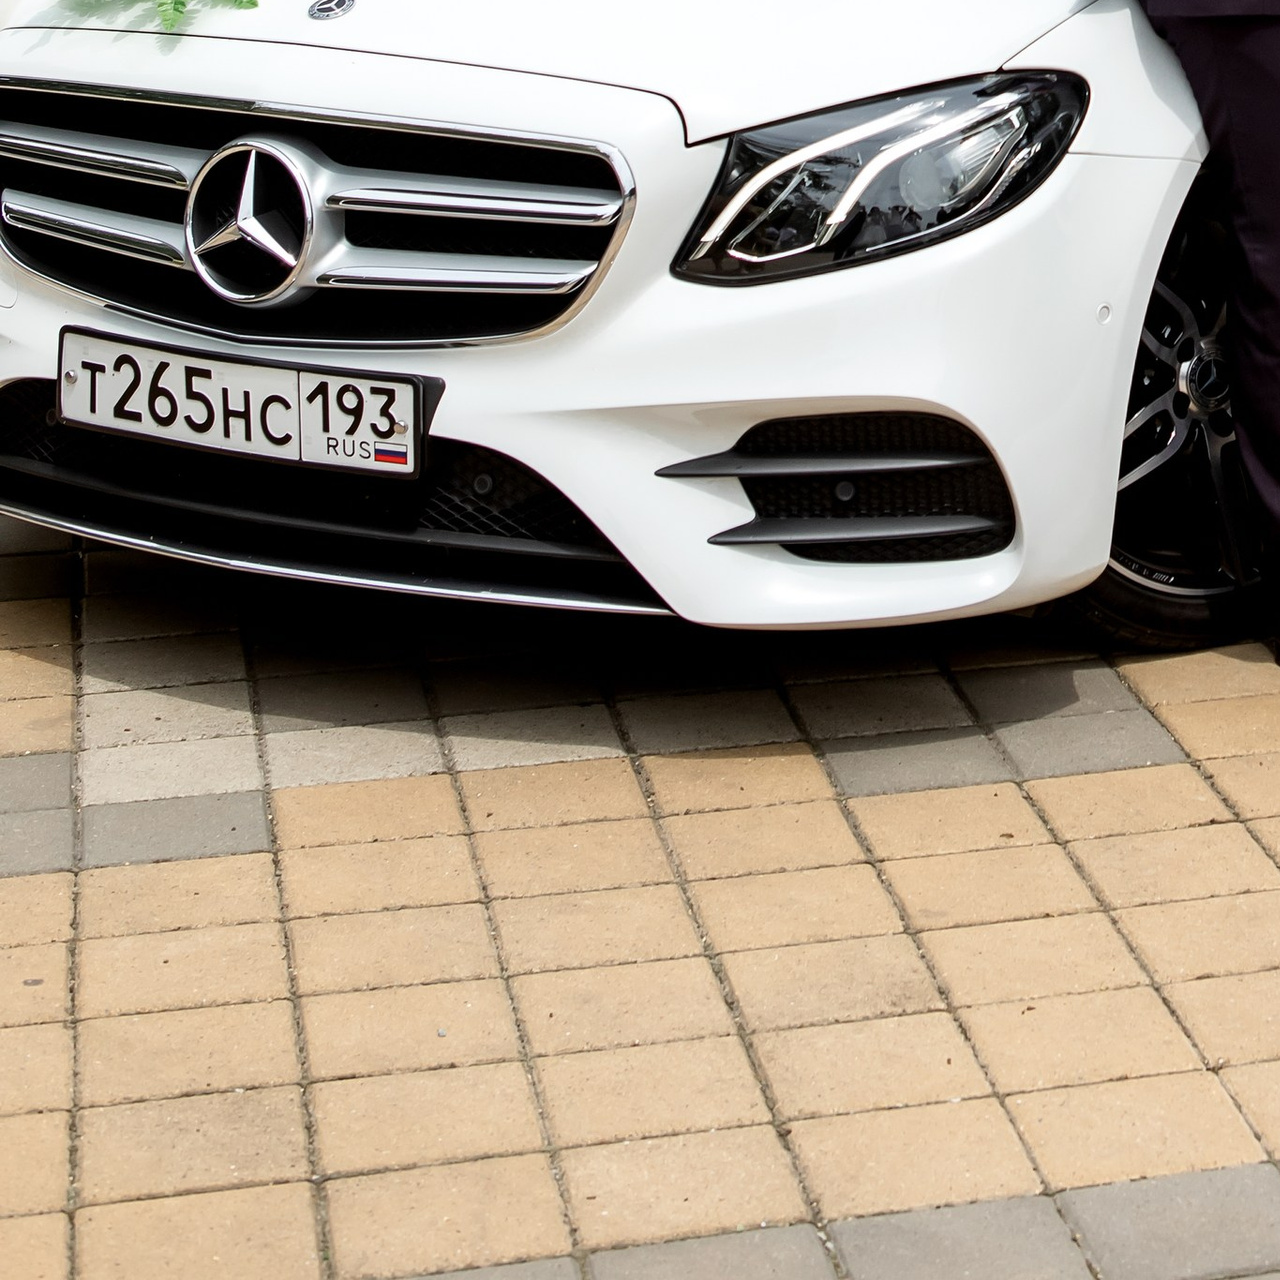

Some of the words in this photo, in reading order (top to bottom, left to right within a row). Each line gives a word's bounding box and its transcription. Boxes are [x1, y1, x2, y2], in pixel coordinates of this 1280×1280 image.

[81, 354, 293, 446] Т265НС
[306, 381, 397, 439] 193
[327, 437, 371, 460] RUS
